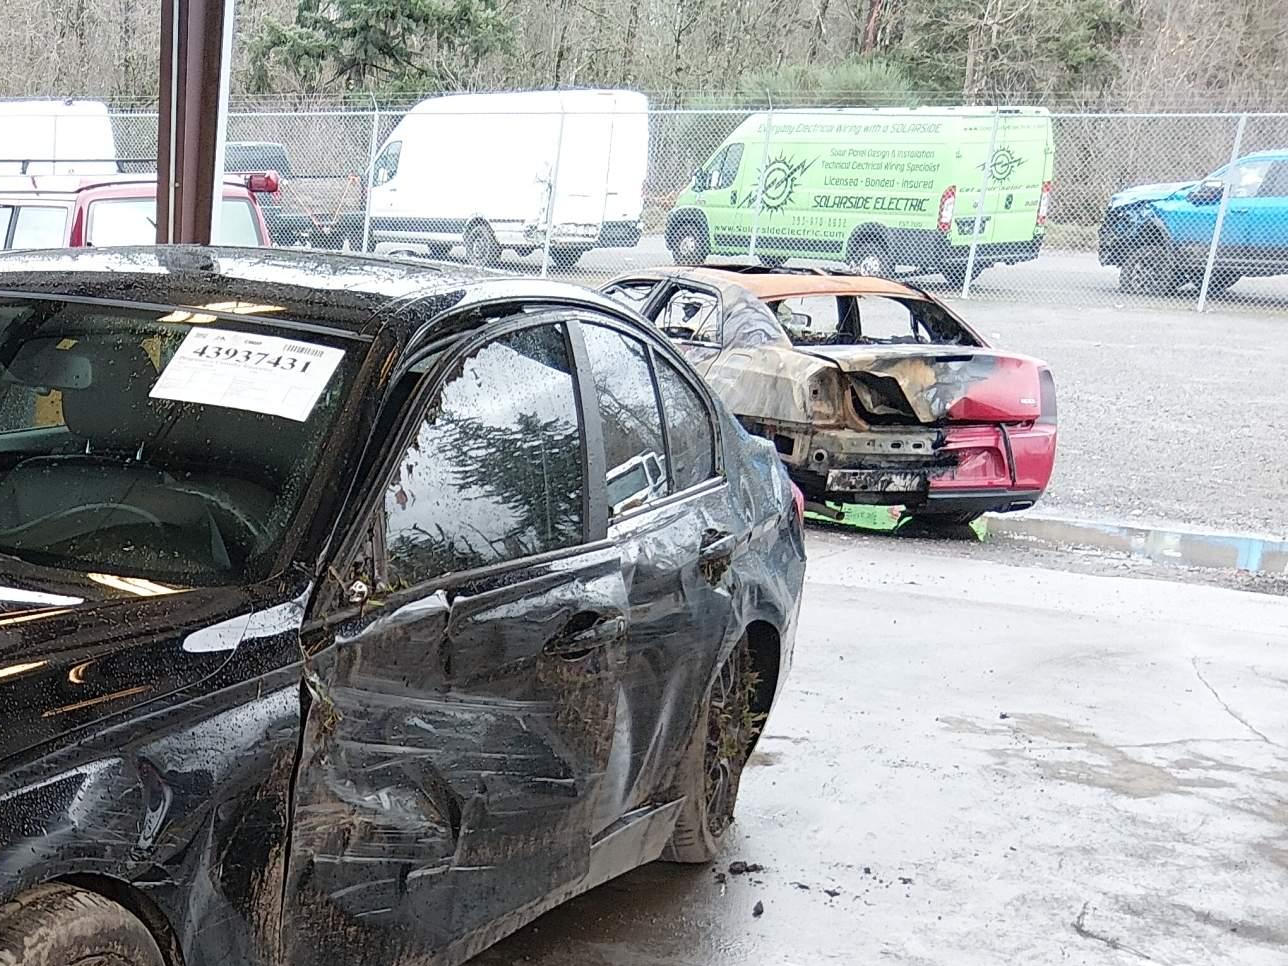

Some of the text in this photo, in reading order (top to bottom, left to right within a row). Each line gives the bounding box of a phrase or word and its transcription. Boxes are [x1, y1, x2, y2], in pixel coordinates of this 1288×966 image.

[890, 123, 943, 133] SOLARSIDE
[824, 175, 859, 187] Licensed
[865, 177, 895, 188] Bonded
[901, 178, 934, 189] Insured
[812, 195, 930, 212] SOLARSIDE ELECTRIC
[714, 224, 845, 238] www.SolrsideElectric.com
[193, 344, 311, 373] 43937431
